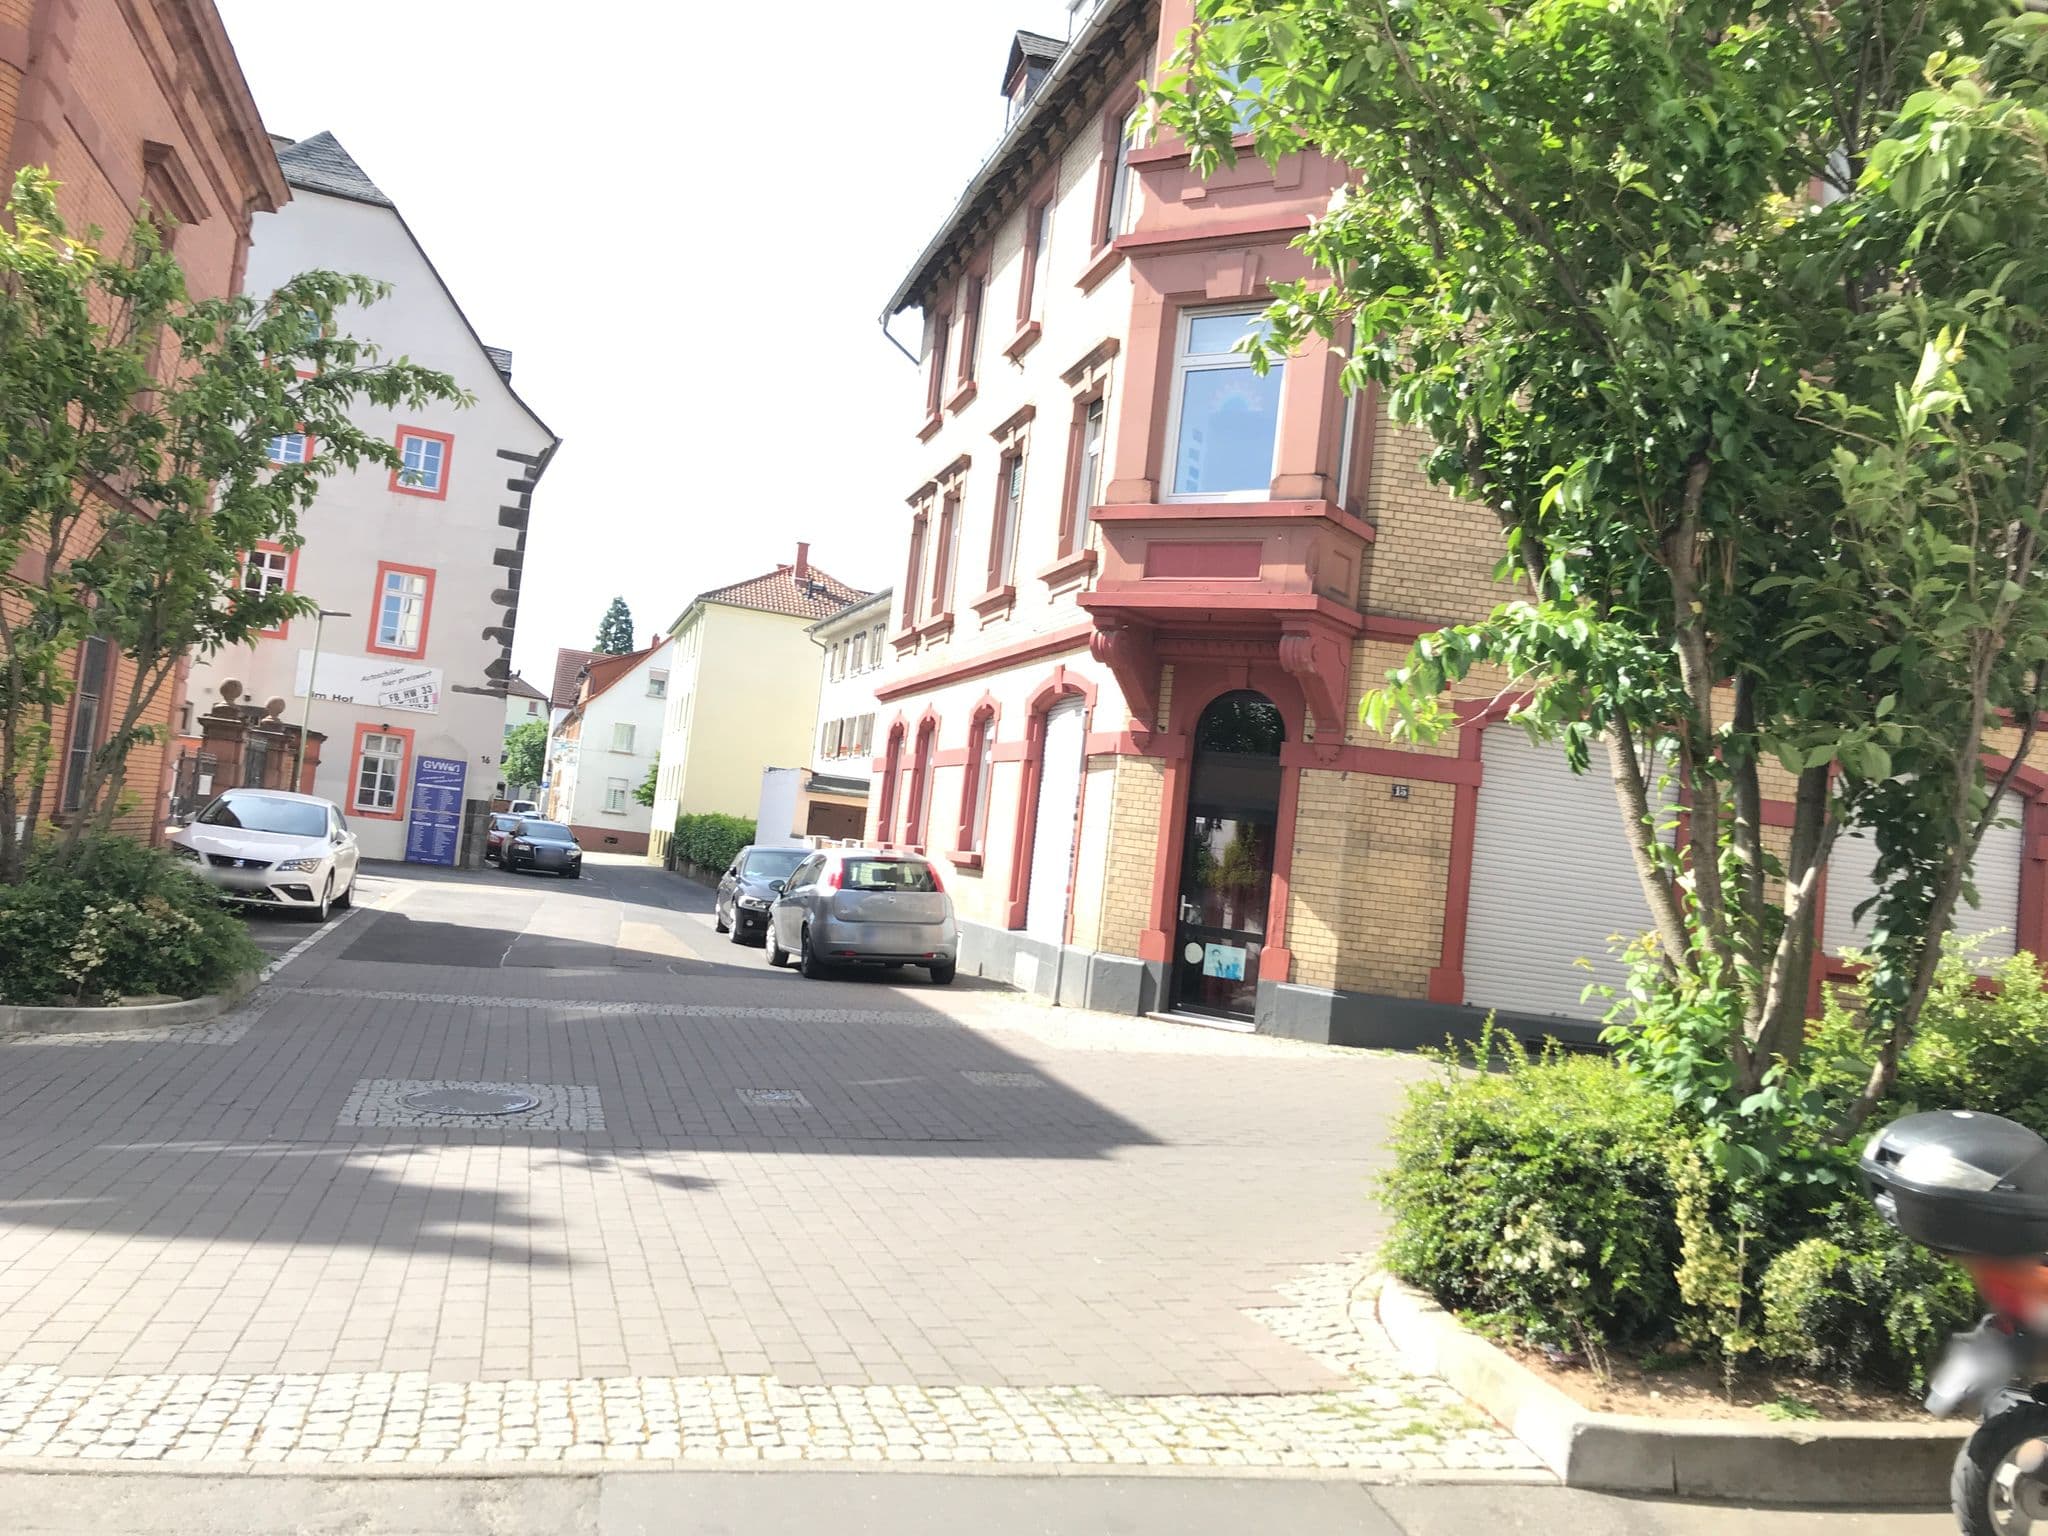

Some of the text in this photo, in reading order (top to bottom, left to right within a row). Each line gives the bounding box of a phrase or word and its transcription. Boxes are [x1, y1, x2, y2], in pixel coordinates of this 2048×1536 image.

[421, 685, 433, 694] 33
[332, 694, 354, 703] Hof
[1394, 785, 1407, 796] 15
